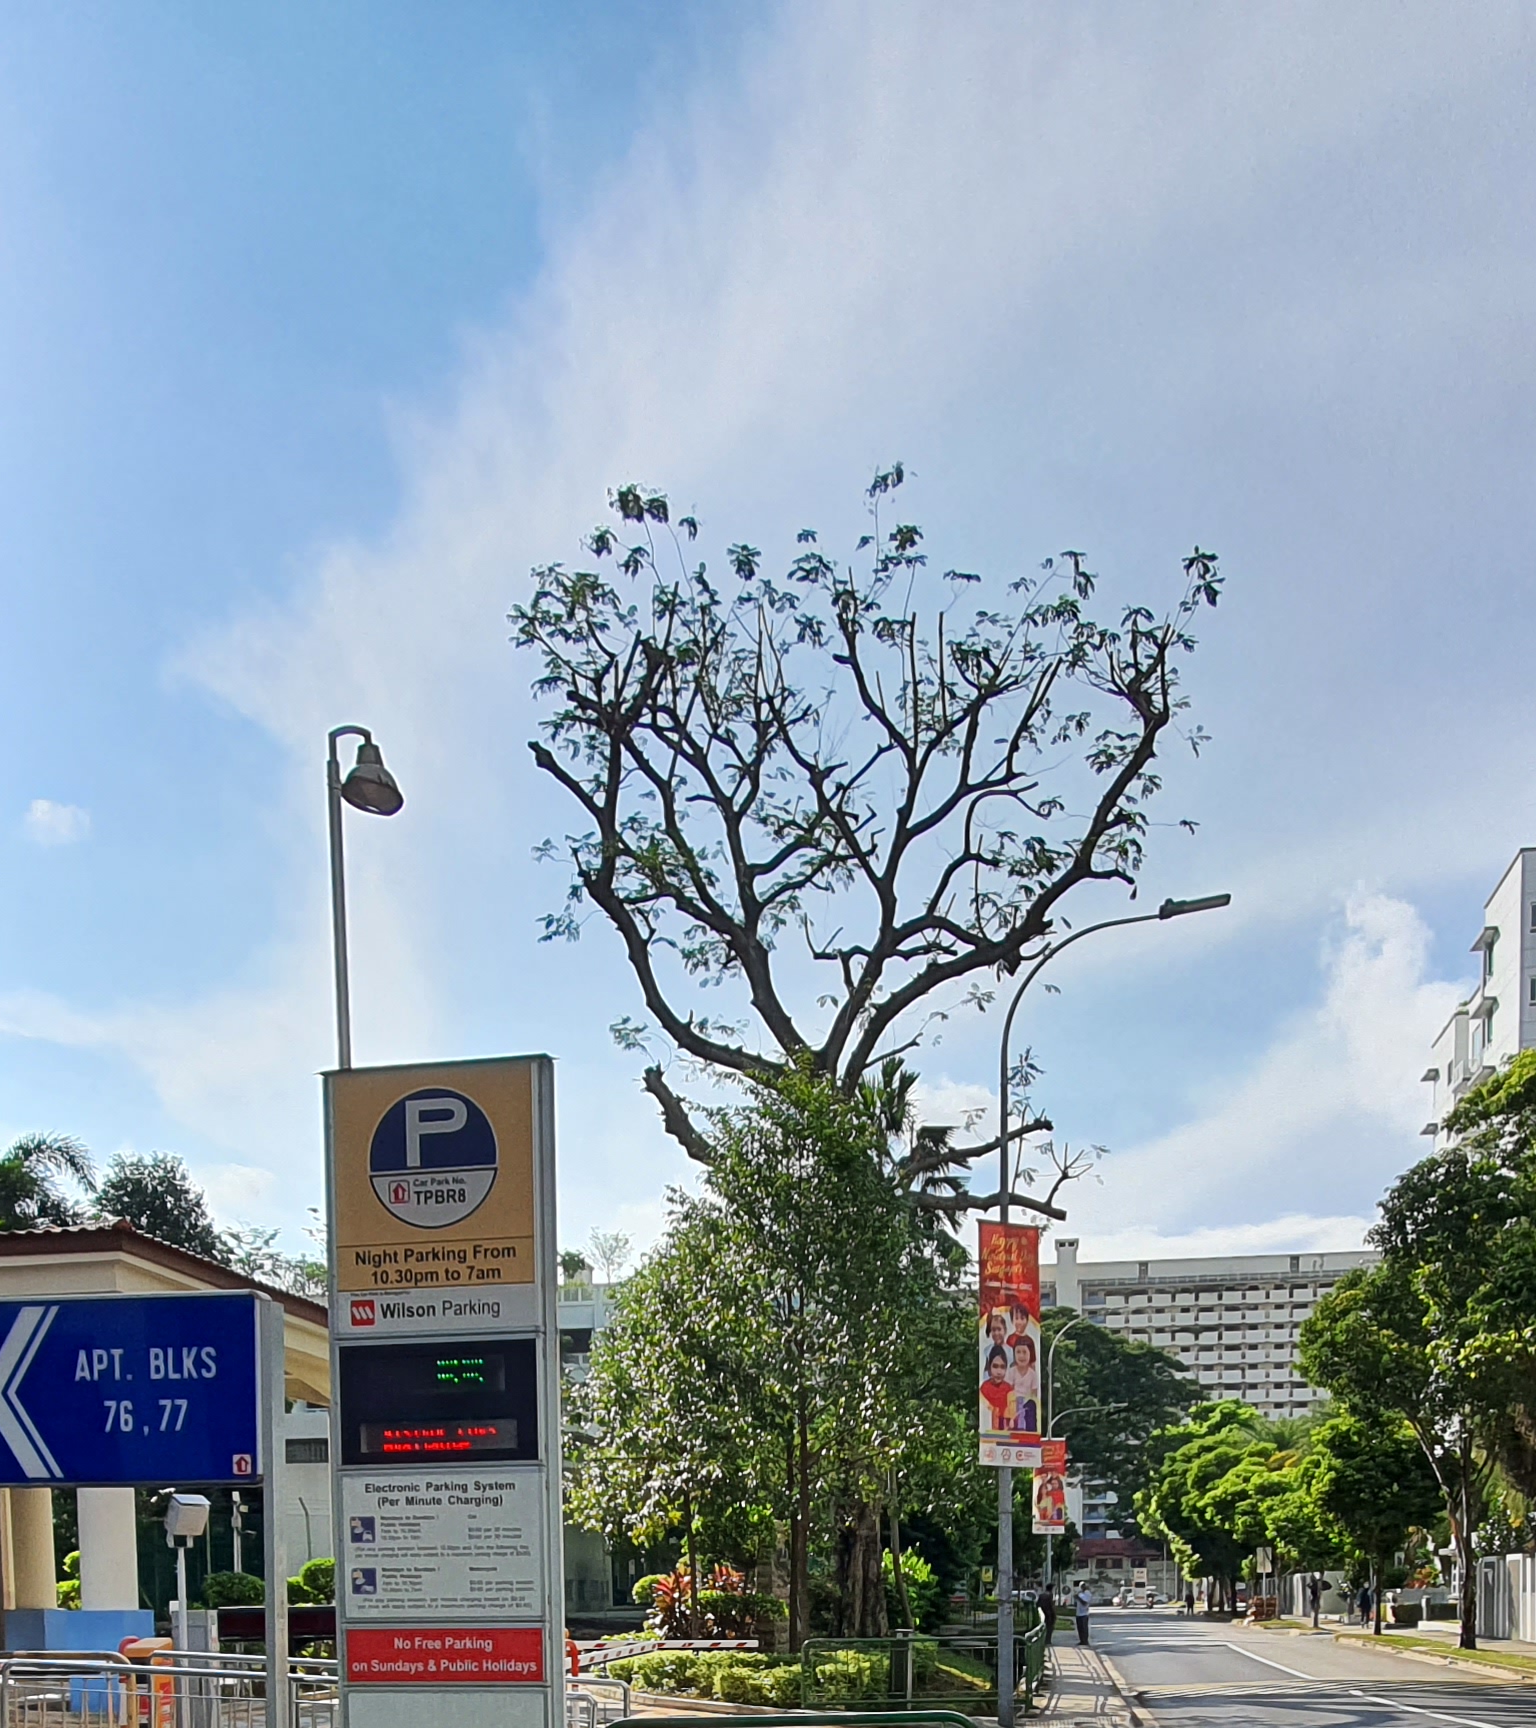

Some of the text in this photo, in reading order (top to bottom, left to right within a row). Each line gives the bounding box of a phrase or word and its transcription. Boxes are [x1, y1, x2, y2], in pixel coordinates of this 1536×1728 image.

[405, 1097, 468, 1167] P
[430, 1176, 450, 1186] Park
[414, 1188, 466, 1205] TPBR8
[355, 1244, 516, 1268] Night Parking From
[371, 1265, 501, 1285] 10.30pm to 7am
[381, 1299, 500, 1319] Wilson Parking
[74, 1346, 217, 1381] APT. BLKS
[365, 1481, 516, 1494] Electronic Parking System
[378, 1494, 504, 1509] (Per Minute Charging)
[394, 1637, 493, 1652] No Free Parking
[352, 1659, 537, 1674] on Sundays & Public Holidays
